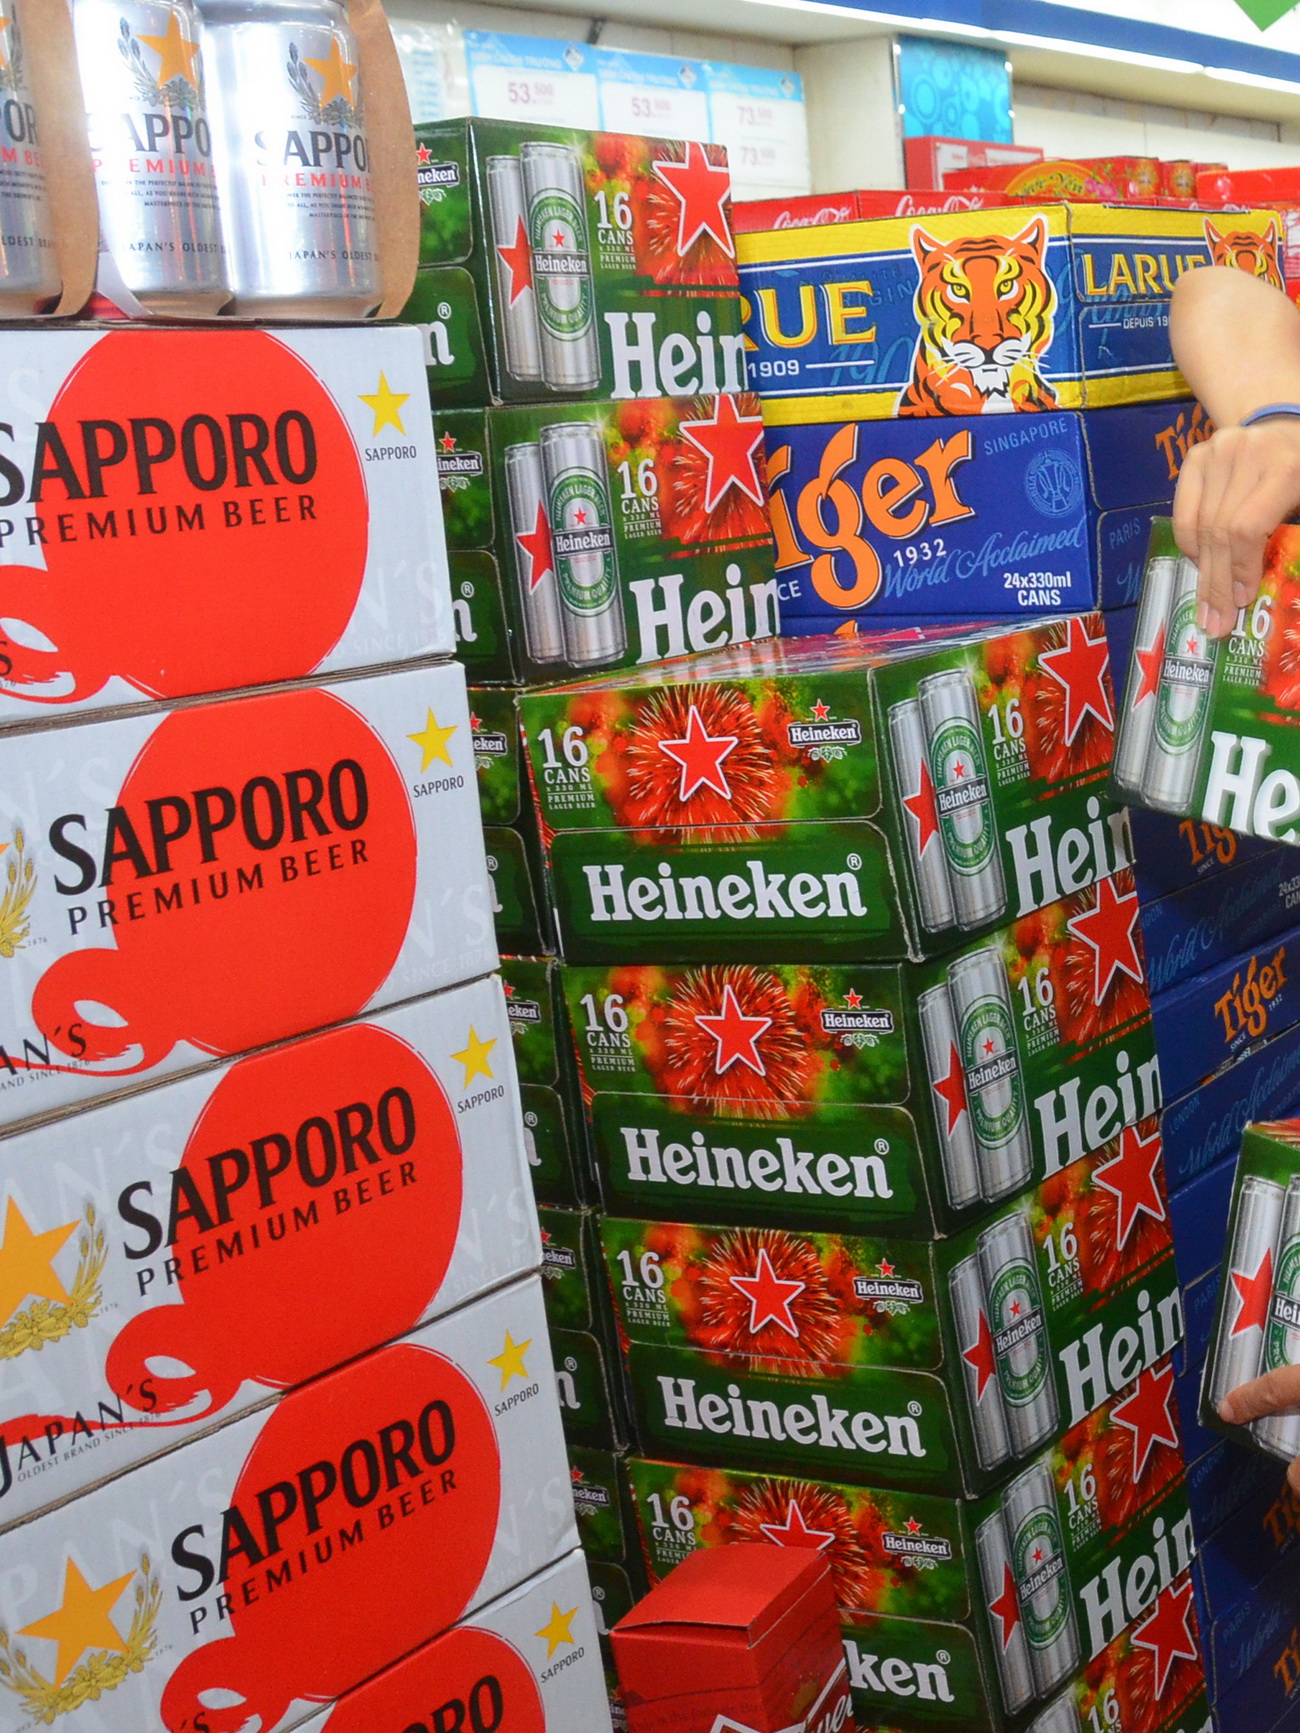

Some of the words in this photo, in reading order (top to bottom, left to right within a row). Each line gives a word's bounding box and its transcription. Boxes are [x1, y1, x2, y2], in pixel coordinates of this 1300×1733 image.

[594, 190, 634, 231] 16
[597, 229, 635, 246] CANS
[535, 254, 588, 275] Heineken
[1123, 316, 1154, 330] DEPUIS
[1156, 316, 1171, 328] 19
[747, 359, 800, 378] 1909
[983, 417, 1068, 456] SINGAPORE
[0, 409, 318, 508] SAPPORO
[364, 445, 418, 463] SAPPORO
[616, 458, 659, 500] 16
[224, 493, 318, 529] BEER
[620, 496, 660, 516] CANS
[765, 422, 976, 610] iger
[555, 531, 611, 553] Heineken
[1109, 518, 1142, 550] PARIS
[893, 537, 947, 568] 1932
[1017, 589, 1062, 607] CANS
[1228, 636, 1266, 658] CANS
[1163, 659, 1211, 684] Heineken
[1223, 665, 1263, 679] PREMIUM
[790, 725, 858, 743] Heineken
[987, 697, 1025, 746] 16
[537, 725, 590, 769] 16
[992, 736, 1027, 762] CANS
[412, 774, 466, 799] SAPPORO
[544, 766, 591, 786] CANS
[547, 793, 595, 803] PREMIUM
[938, 782, 988, 813] Heineken
[47, 758, 370, 897] SAPPORO
[67, 862, 265, 937] PREMIUM
[281, 838, 370, 884] BEER
[1016, 966, 1054, 1017] 16
[1213, 946, 1289, 1044] Tiger
[579, 993, 629, 1034] 16
[823, 1013, 890, 1030] Heineken
[1023, 1005, 1057, 1032] CANS
[0, 1022, 88, 1077] AN'S
[586, 1031, 632, 1049] CANS
[590, 1056, 636, 1067] PREMIUM
[968, 1055, 1018, 1091] Heineken
[0, 1075, 26, 1093] AND
[456, 1084, 506, 1115] SAPPORO
[117, 1086, 417, 1261] SAPPORO
[135, 1200, 320, 1298] PREMIUM
[333, 1160, 419, 1216] BEER
[1042, 1221, 1079, 1274] 16
[616, 1249, 665, 1290] 16
[1048, 1258, 1081, 1288] CANS
[621, 1286, 667, 1304] CANS
[856, 1280, 920, 1299] Heineken
[626, 1309, 671, 1322] PREMIUM
[995, 1312, 1042, 1349] Heineken
[493, 1382, 541, 1419] SAPPORO
[17, 1457, 60, 1483] OLDEST
[63, 1440, 101, 1461] BRAND
[169, 1399, 457, 1603] SAPPORO
[1063, 1463, 1097, 1517] 16
[646, 1492, 696, 1532] 16
[1068, 1498, 1100, 1530] CANS
[652, 1527, 697, 1546] CANS
[885, 1536, 949, 1556] Heineken
[188, 1522, 364, 1637] PREMIUM
[378, 1468, 459, 1531] BEER
[1019, 1556, 1064, 1599] Heineken
[540, 1646, 586, 1684] SAPPORO
